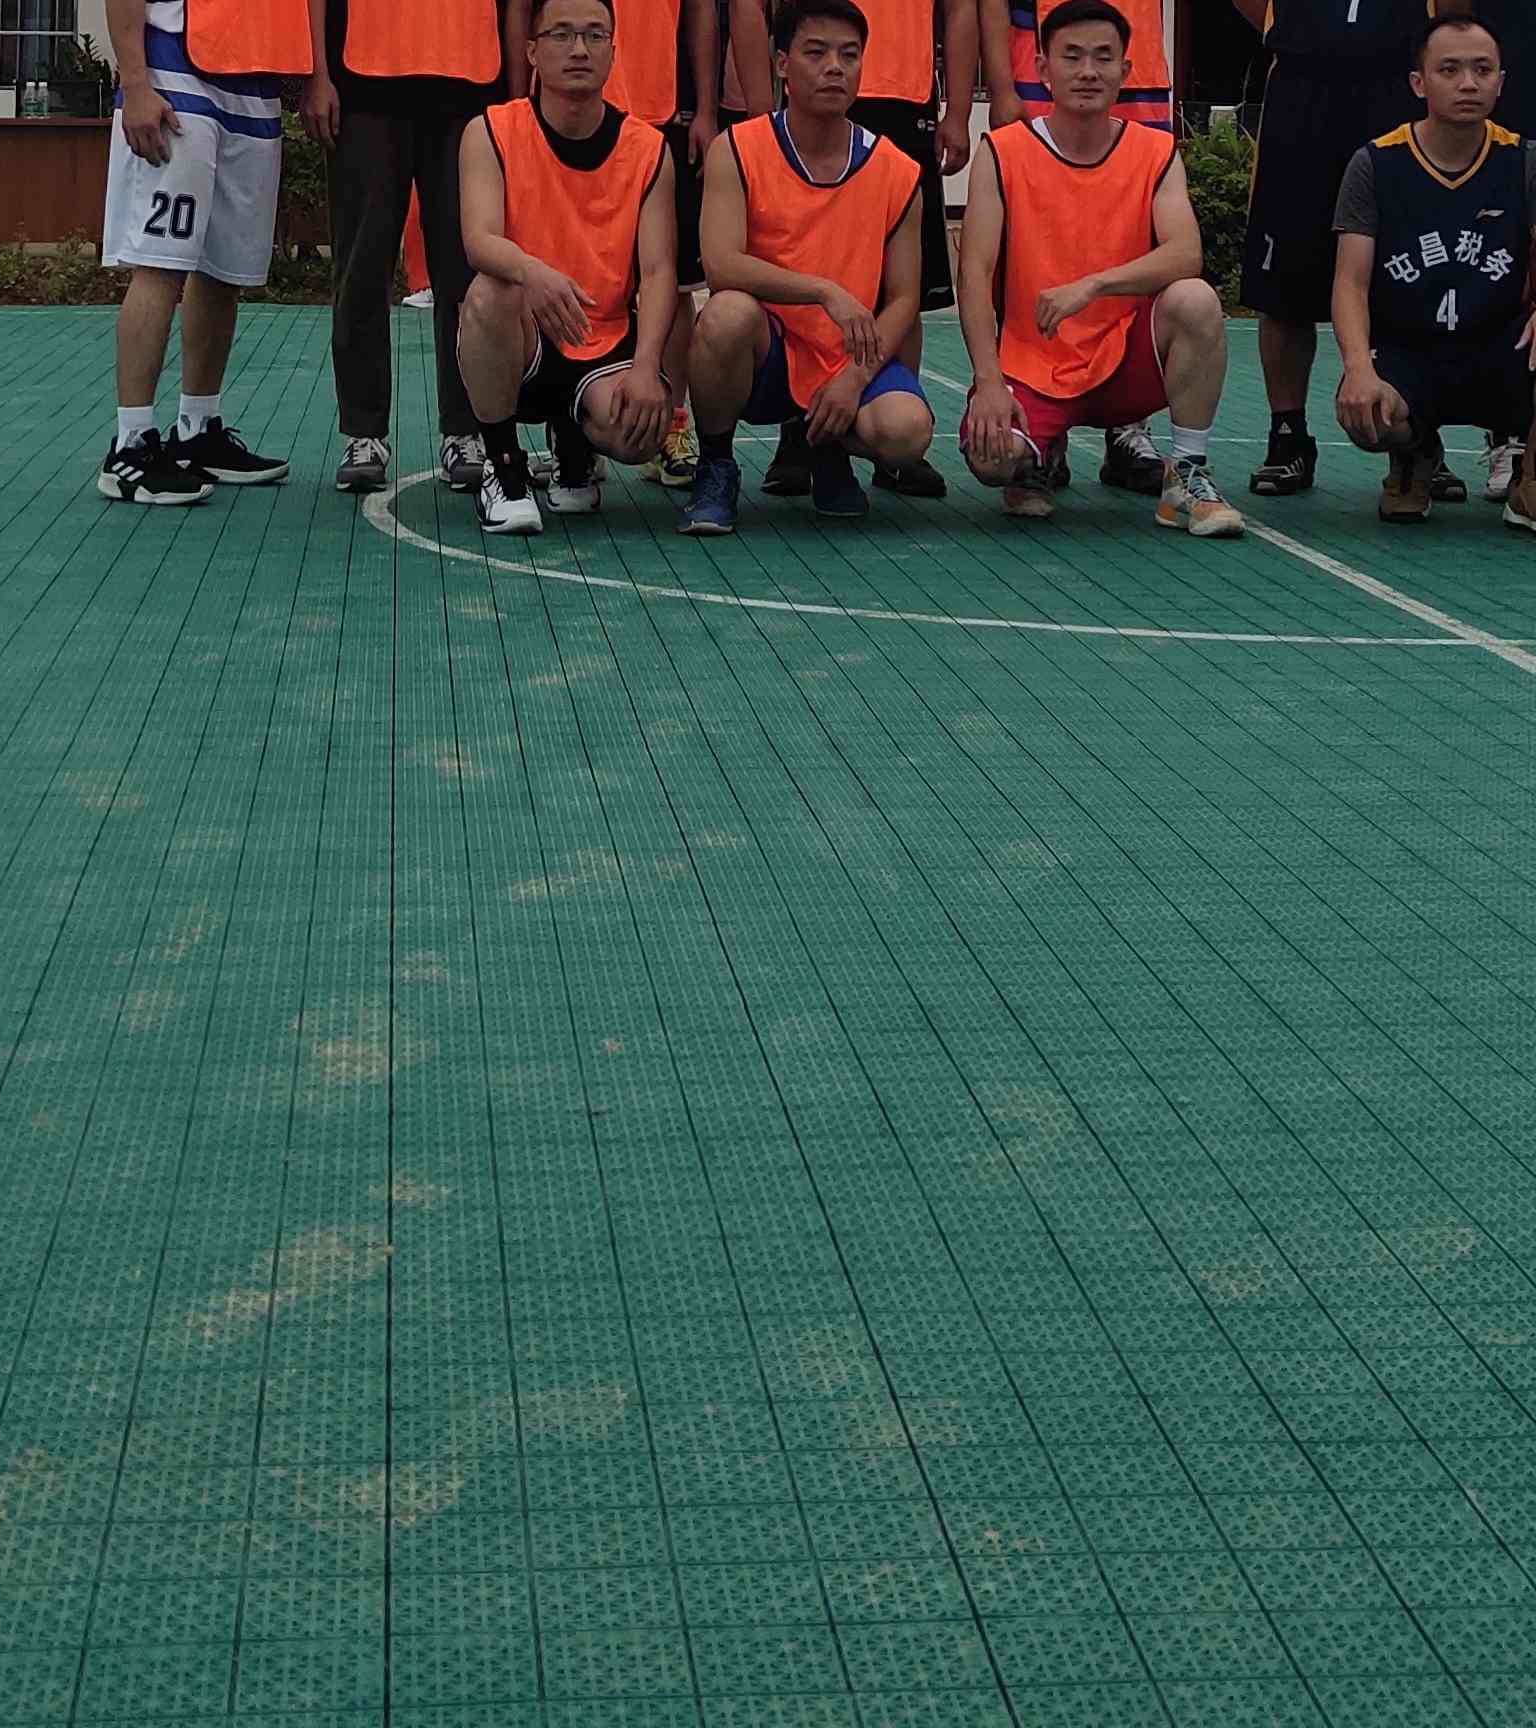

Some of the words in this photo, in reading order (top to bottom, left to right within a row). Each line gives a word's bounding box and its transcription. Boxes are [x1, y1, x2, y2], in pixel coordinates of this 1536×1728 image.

[143, 190, 198, 240] 20
[1383, 229, 1515, 284] 屯昌税务
[1435, 288, 1460, 331] 4
